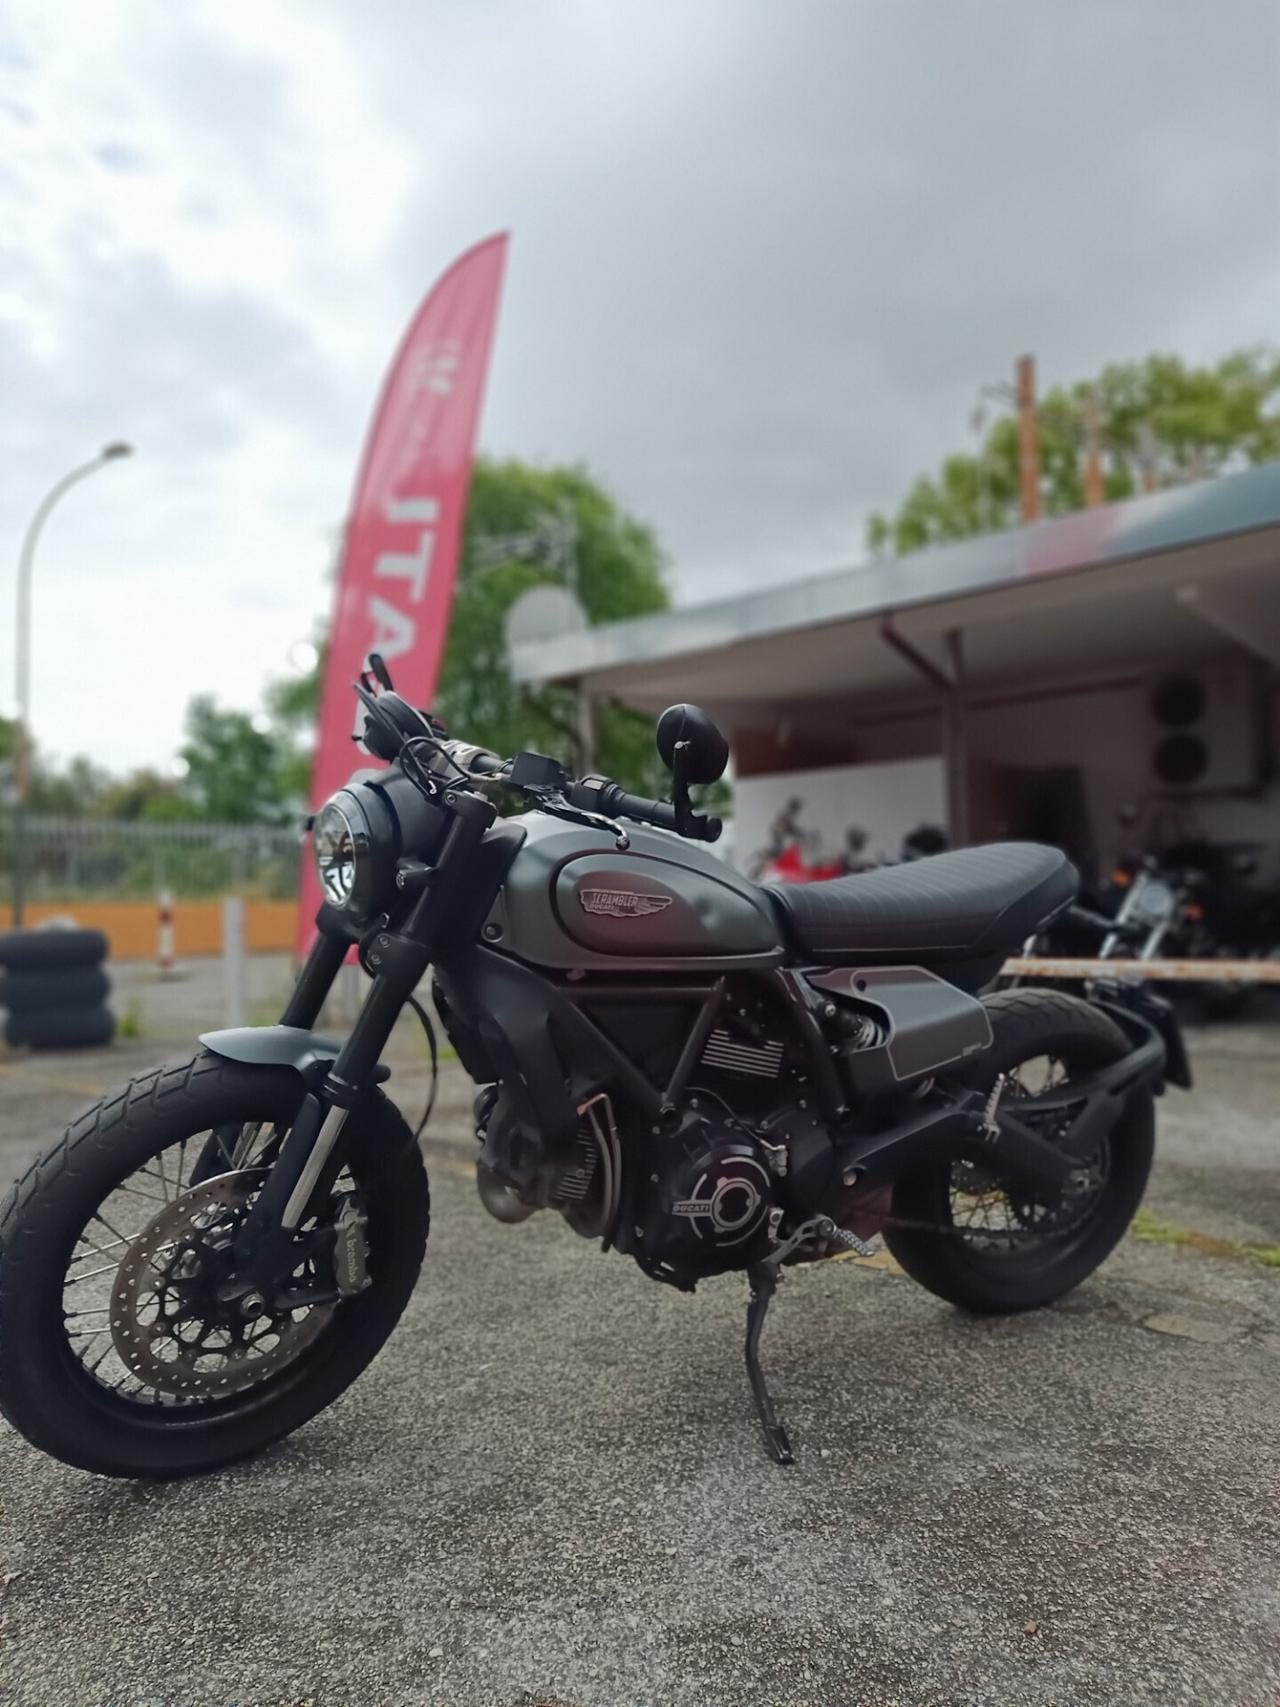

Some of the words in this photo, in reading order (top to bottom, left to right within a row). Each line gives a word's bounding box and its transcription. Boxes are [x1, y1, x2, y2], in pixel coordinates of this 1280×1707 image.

[592, 892, 638, 907] SCRAMBLER
[672, 1204, 710, 1213] DUCATI
[347, 1238, 358, 1282] brembo
